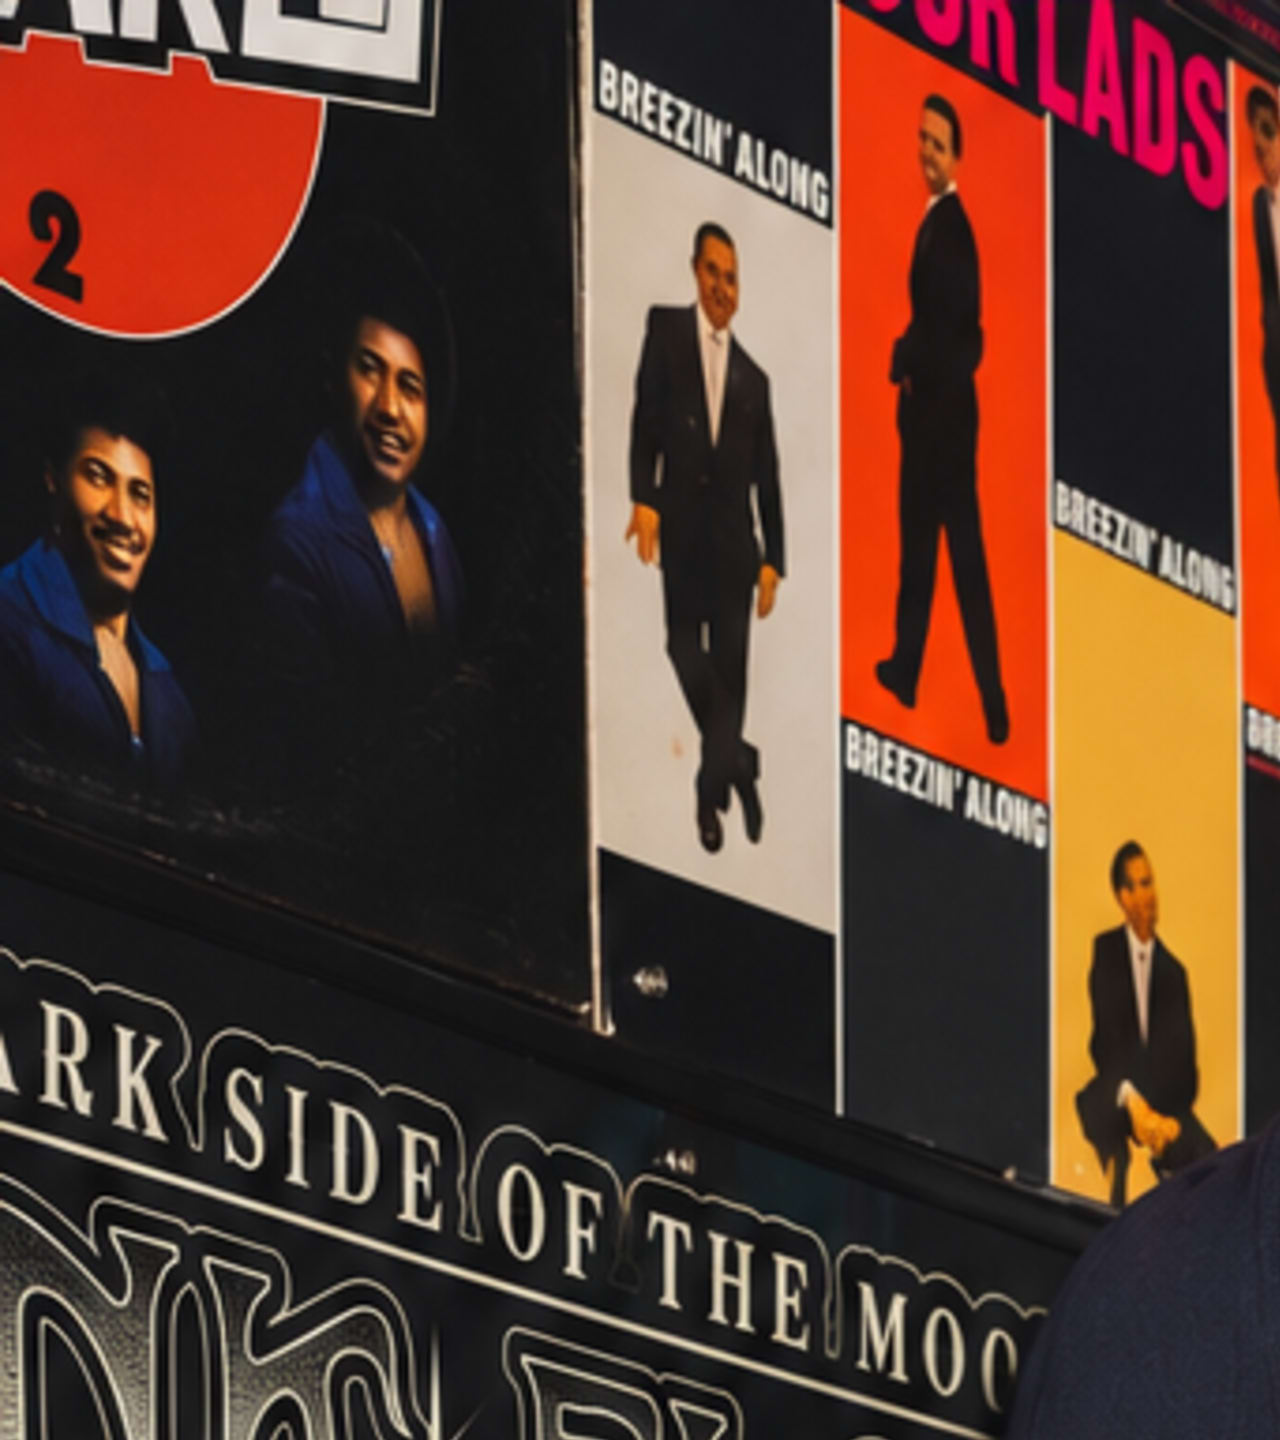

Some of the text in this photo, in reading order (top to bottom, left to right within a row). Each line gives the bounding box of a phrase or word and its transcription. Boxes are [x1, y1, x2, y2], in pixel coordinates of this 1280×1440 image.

[599, 59, 829, 219] BREEZIN' ALONG
[1037, 0, 1228, 210] LADS
[29, 189, 83, 304] 2
[1159, 535, 1236, 611] ALONG
[965, 777, 1047, 850] ALONG
[224, 1067, 442, 1233] SIDE
[497, 1163, 603, 1280] OF
[647, 1210, 810, 1352] THE
